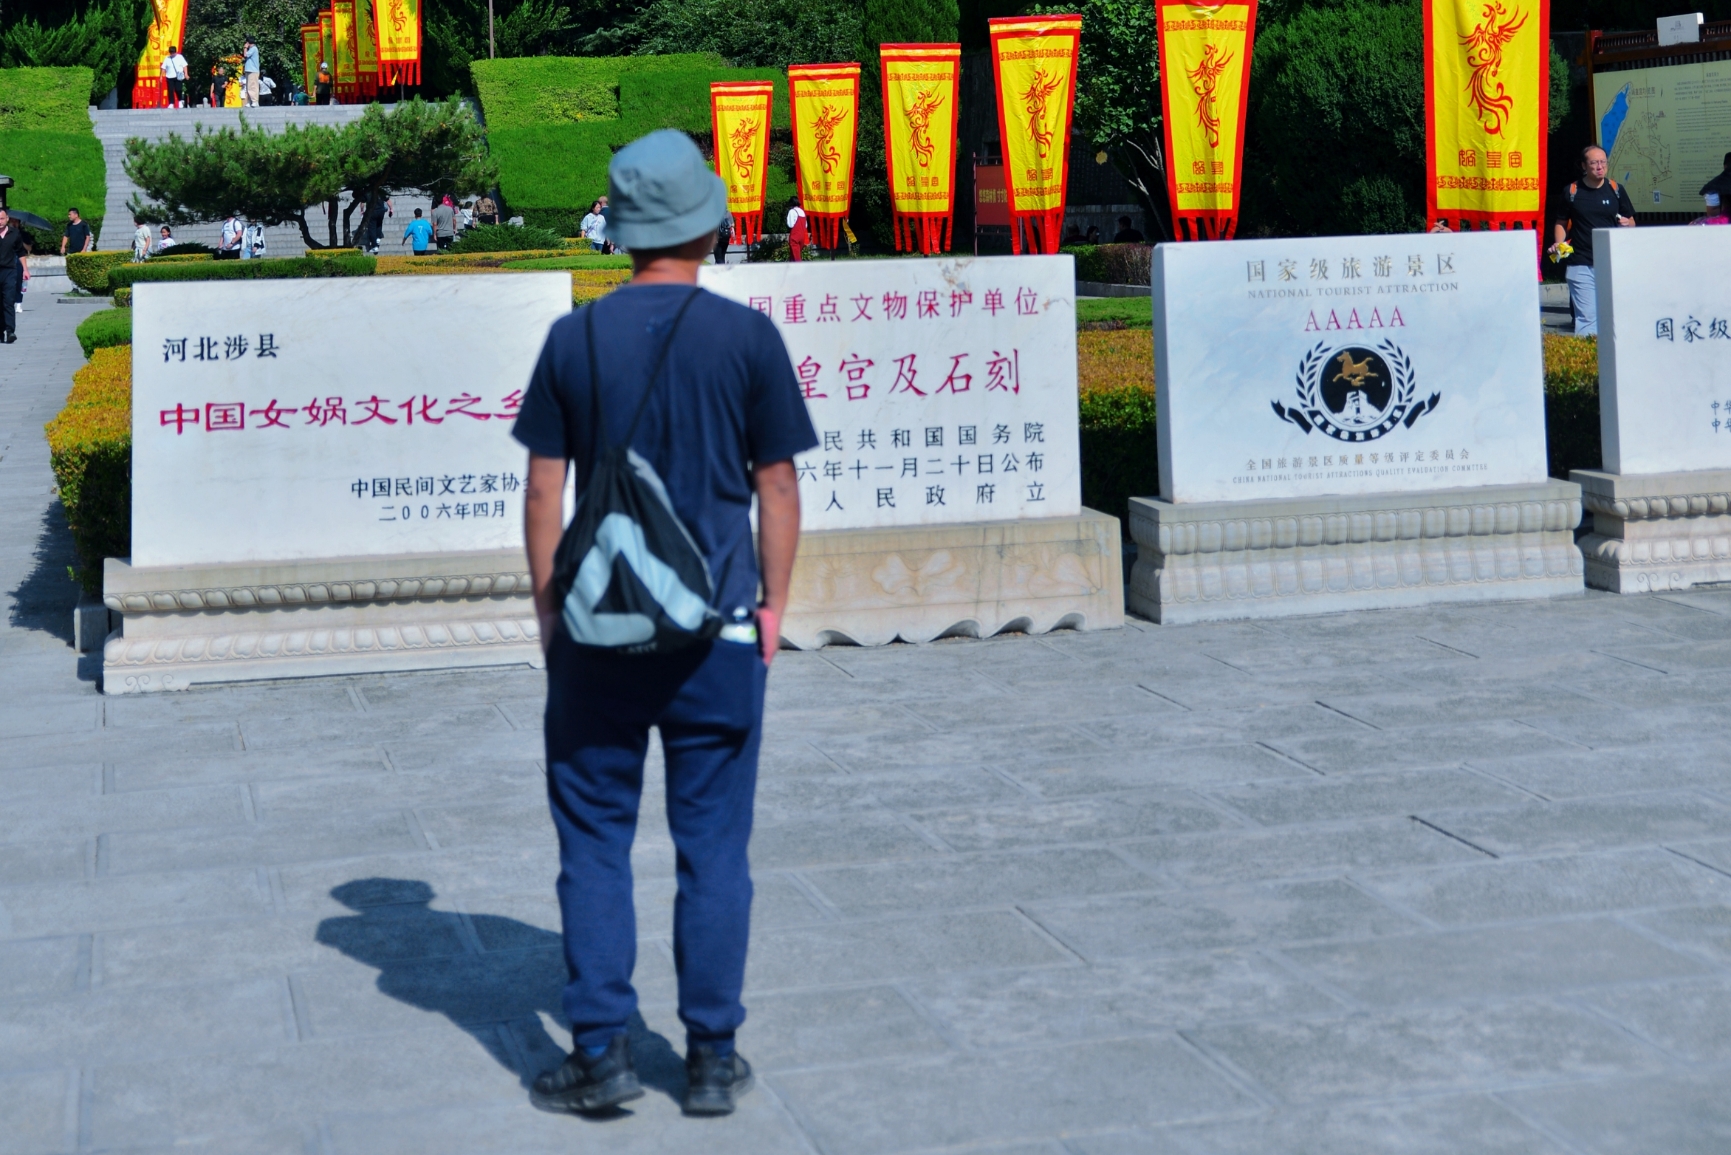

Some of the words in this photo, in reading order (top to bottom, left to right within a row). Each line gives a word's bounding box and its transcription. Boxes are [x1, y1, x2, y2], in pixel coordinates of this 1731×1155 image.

[1246, 252, 1457, 283] 国家级旅游景区
[1248, 288, 1312, 299] NATIONAL
[1316, 285, 1372, 296] TOURIST
[1377, 282, 1459, 294] ATTRACTION
[1304, 305, 1406, 332] AAAAA
[1655, 315, 1731, 343] 国家级
[162, 333, 280, 363] 河北涉县
[796, 348, 1020, 402] 皇宫及石刻
[823, 422, 1046, 452] 民共和国国务院
[796, 451, 1045, 482] 六年十一月二十日公布
[351, 472, 529, 499] 中国民间文艺家协
[825, 480, 1046, 512] 人民政府立
